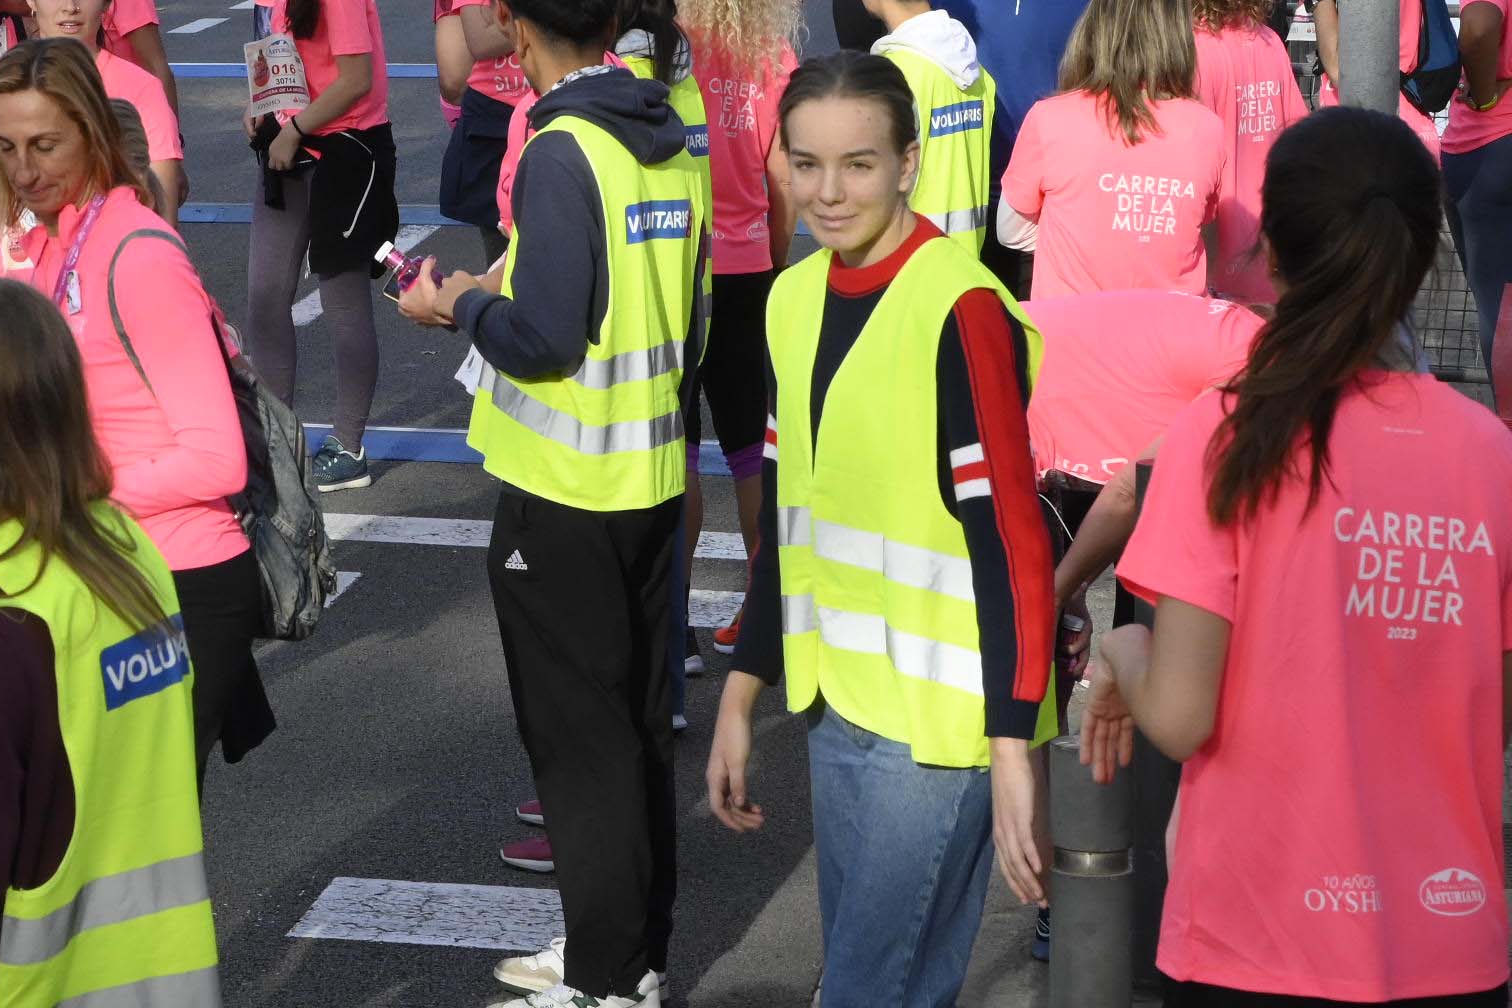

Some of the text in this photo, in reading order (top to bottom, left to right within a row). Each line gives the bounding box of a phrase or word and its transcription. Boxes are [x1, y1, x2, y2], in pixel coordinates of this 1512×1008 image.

[271, 64, 296, 75] 016
[1257, 99, 1274, 116] LA
[1238, 115, 1277, 136] MUJER
[686, 132, 709, 149] TARIS
[1098, 173, 1196, 199] CARRERA
[1117, 194, 1175, 215] DE LA
[1111, 213, 1177, 235] MUJER
[1333, 507, 1495, 556] CARRERA
[504, 562, 528, 571] adidas
[1357, 547, 1458, 588] DE LA
[1344, 590, 1464, 626] MUJER
[1386, 625, 1417, 641] 2023
[1341, 873, 1377, 889] AÑOS
[1303, 888, 1383, 913] OYSH
